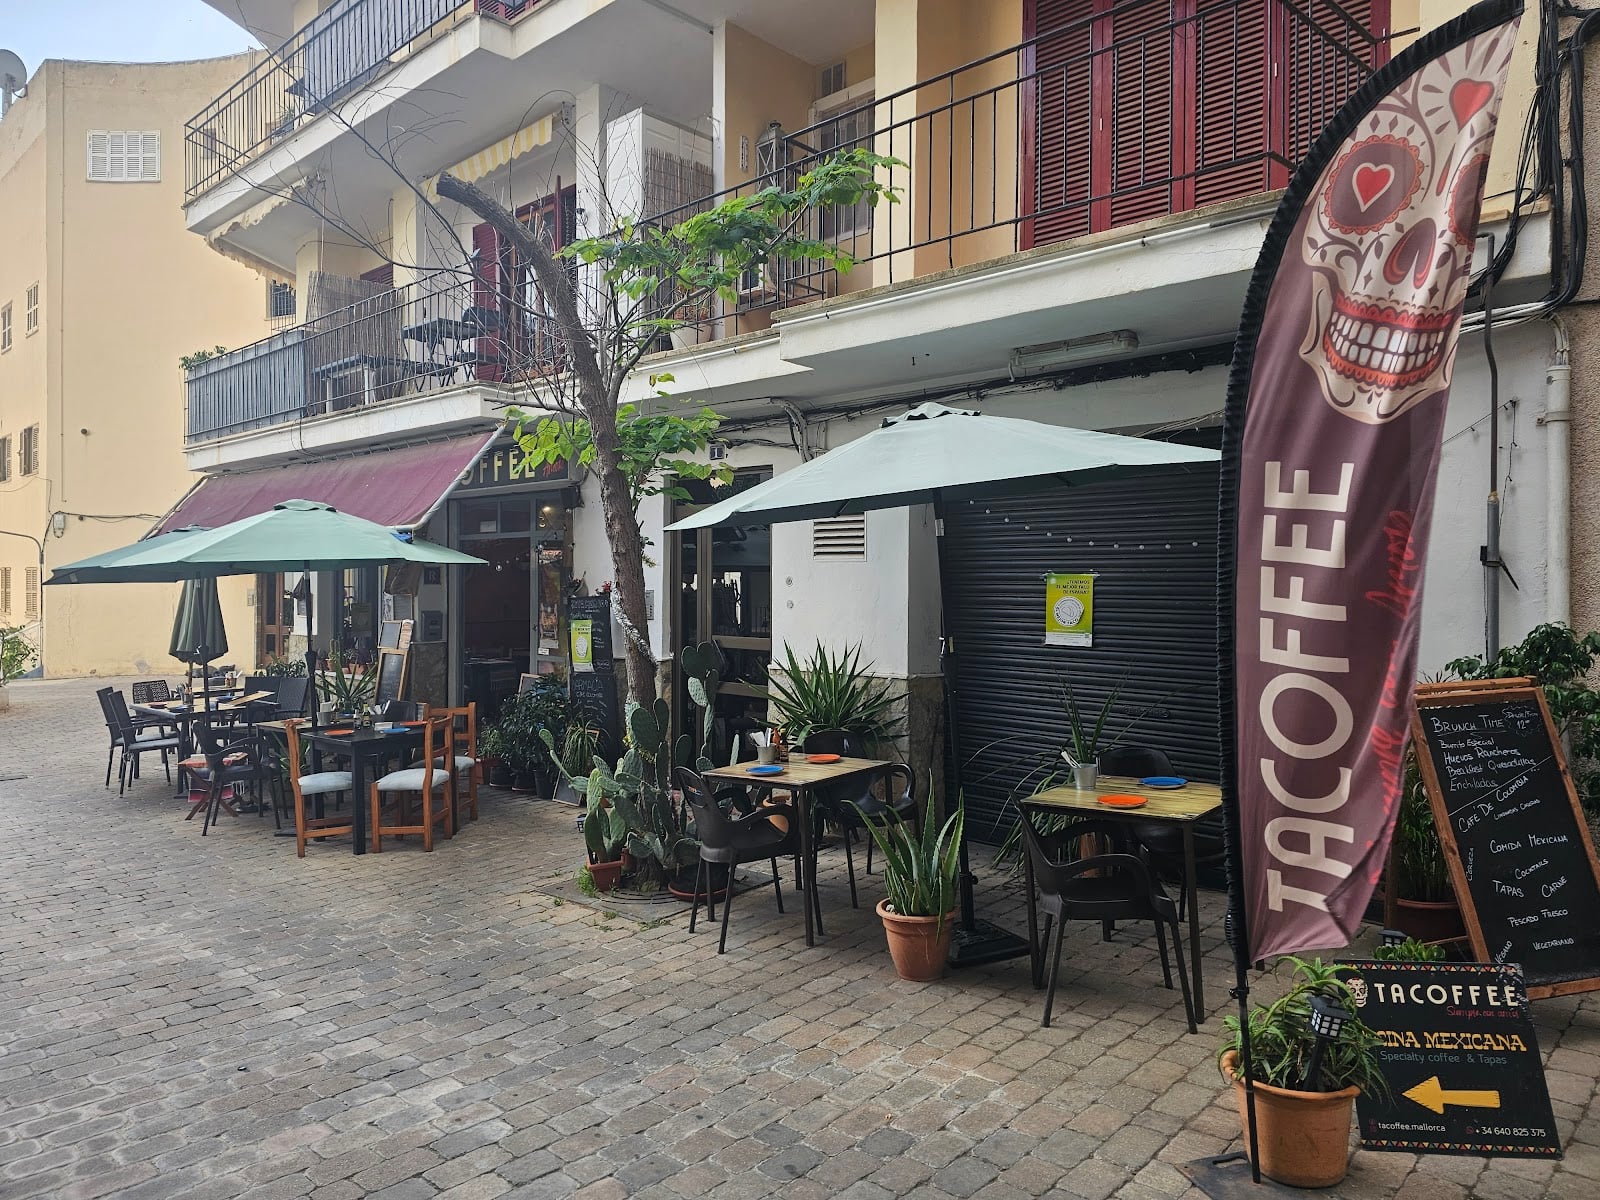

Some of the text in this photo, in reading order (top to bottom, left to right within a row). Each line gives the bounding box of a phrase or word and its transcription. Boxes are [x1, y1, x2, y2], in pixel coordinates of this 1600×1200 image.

[1259, 461, 1355, 913] TACOFFEE
[1439, 737, 1495, 748] Burrito Especial
[1443, 746, 1521, 765] Huevos Rancheros
[1450, 777, 1499, 792] Enchiladas
[1495, 775, 1529, 801] COLOMBIA
[1490, 833, 1569, 854] COMIDA MEXICANA
[1492, 880, 1525, 898] TAPAS
[1541, 876, 1568, 898] CARNE
[1507, 909, 1569, 928] PESCADO FRESCO
[1533, 937, 1575, 951] VEGETARIANO
[1373, 983, 1520, 1007] TACOFFEE
[1423, 1031, 1527, 1052] MEXICANA
[1380, 1050, 1507, 1066] Specialty coffee & Tapas
[1378, 1122, 1446, 1132] tacoffee.mallorca
[1494, 1127, 1511, 1136] 640
[1512, 1127, 1529, 1137] 825
[1531, 1128, 1547, 1138] 375
